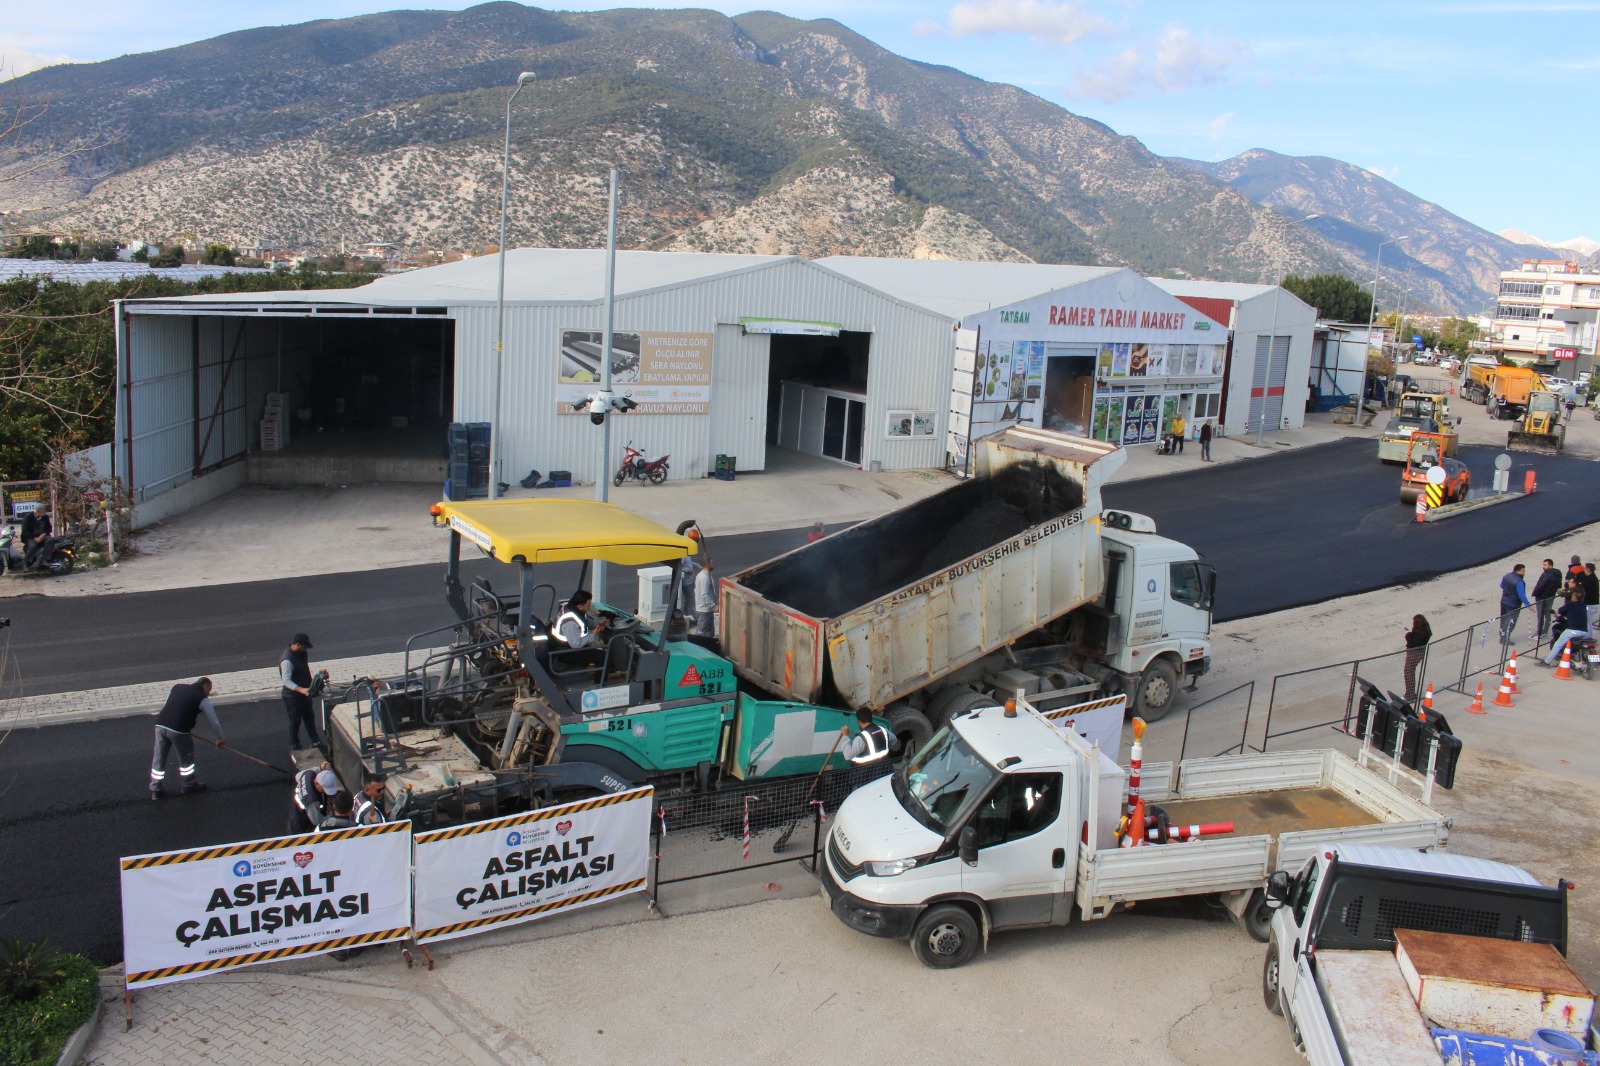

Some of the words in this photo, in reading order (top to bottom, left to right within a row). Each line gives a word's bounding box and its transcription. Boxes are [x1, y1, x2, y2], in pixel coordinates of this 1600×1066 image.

[1000, 310, 1030, 323] TATSAN
[1049, 305, 1096, 327] RAMER
[1099, 308, 1137, 328] TARIM
[1140, 312, 1186, 330] MARKET
[651, 361, 668, 370] SERA
[670, 361, 704, 370] NAYLONU
[643, 373, 683, 382] EBATLAMA
[684, 374, 709, 382] YAPILIR
[638, 403, 663, 412] HAVUZ
[666, 403, 705, 413] NAYLONU
[699, 682, 722, 695] 521
[608, 719, 633, 732] 521
[600, 775, 627, 793] SUPER
[482, 836, 594, 880] ASFALT
[456, 854, 615, 910] ÇALIŞMASI
[205, 870, 341, 913] ASFALT
[175, 893, 370, 948] ÇALIŞMASI
